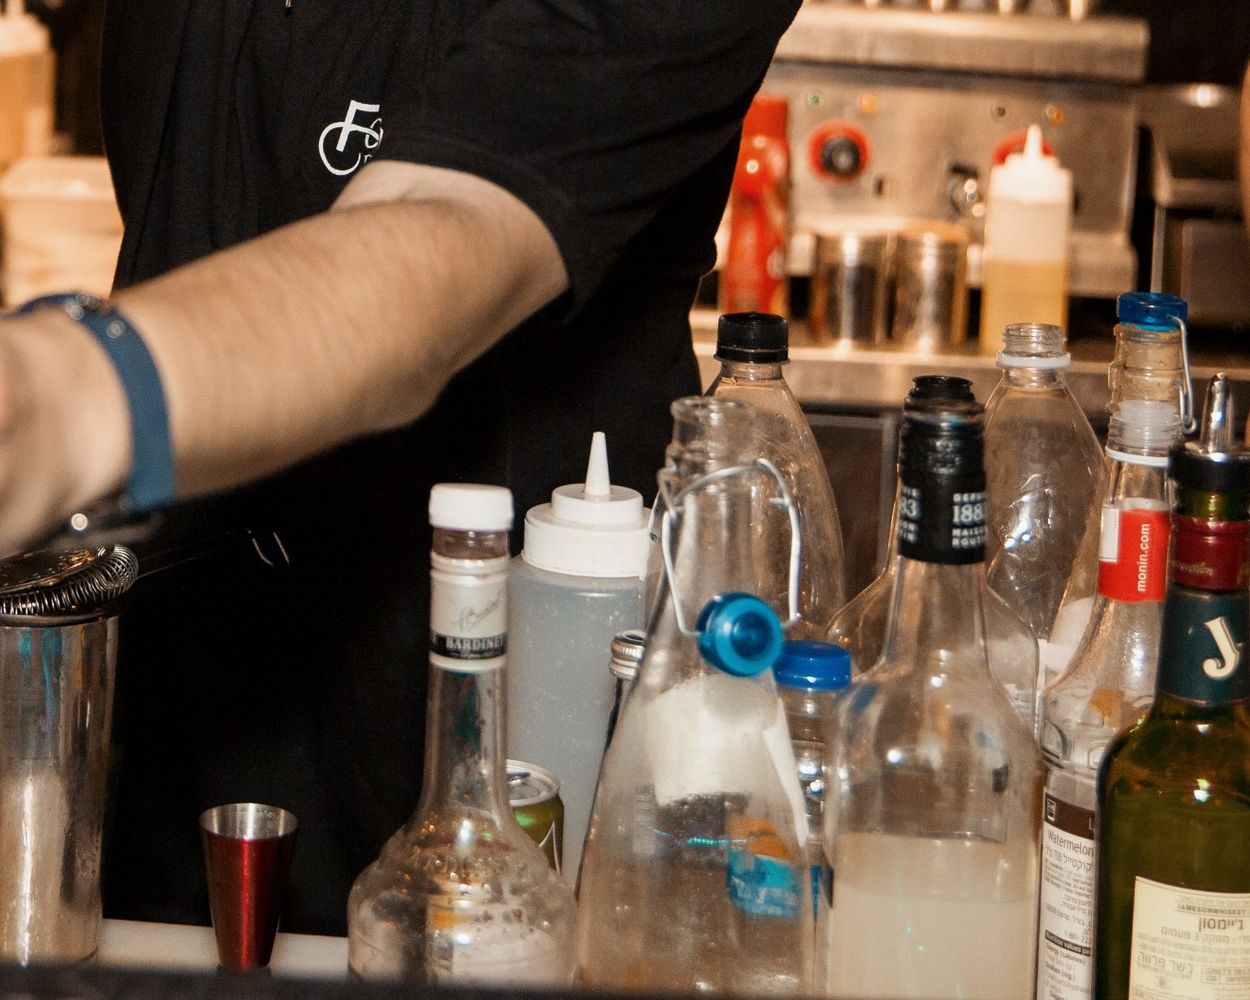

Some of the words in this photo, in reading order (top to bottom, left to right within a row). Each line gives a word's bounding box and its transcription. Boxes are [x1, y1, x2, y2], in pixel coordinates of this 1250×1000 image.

[1137, 523, 1150, 593] monin.com
[1203, 616, 1240, 681] J
[1047, 828, 1095, 857] Watermelon
[1170, 959, 1194, 975] כשר
